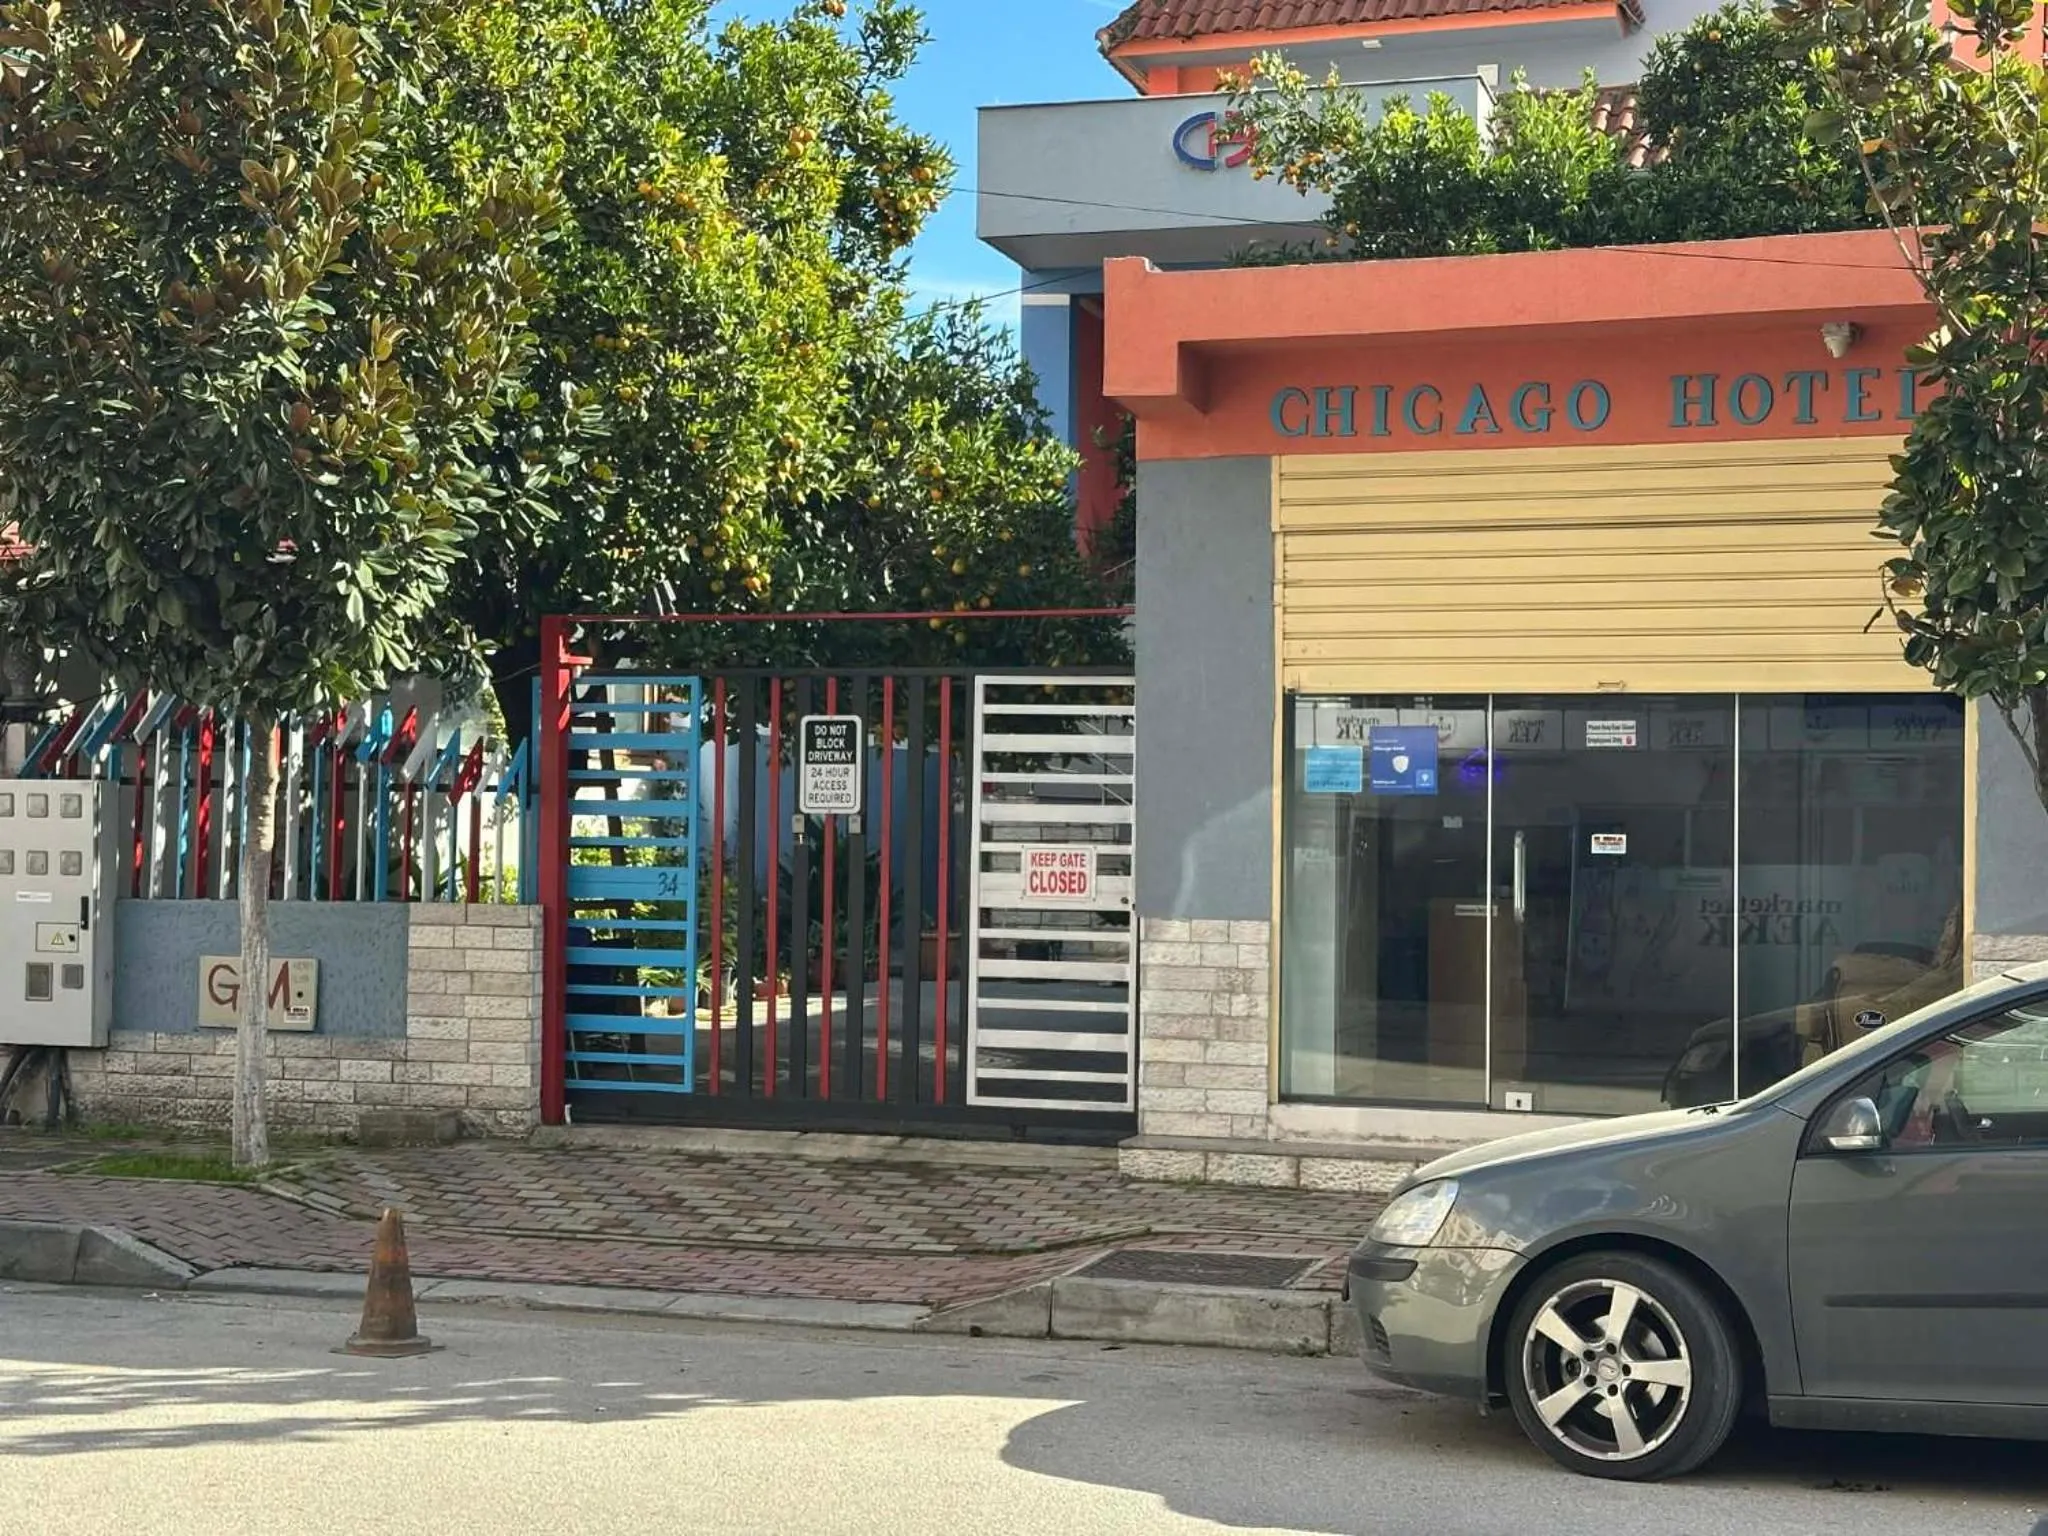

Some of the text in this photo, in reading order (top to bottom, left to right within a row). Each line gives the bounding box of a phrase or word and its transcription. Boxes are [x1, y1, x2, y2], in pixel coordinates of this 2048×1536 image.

[1269, 381, 1611, 438] CHICAGO
[814, 725, 847, 736] DO NOT
[816, 738, 845, 749] BLOCK
[808, 751, 853, 762] DRIVEWAY
[811, 767, 850, 778] 24 HOUR
[813, 781, 848, 791] ACCESS
[808, 793, 852, 804] REQUIRED
[1030, 852, 1087, 868] KEEP GATE
[658, 871, 679, 897] 34
[1030, 871, 1087, 894] CLOSED
